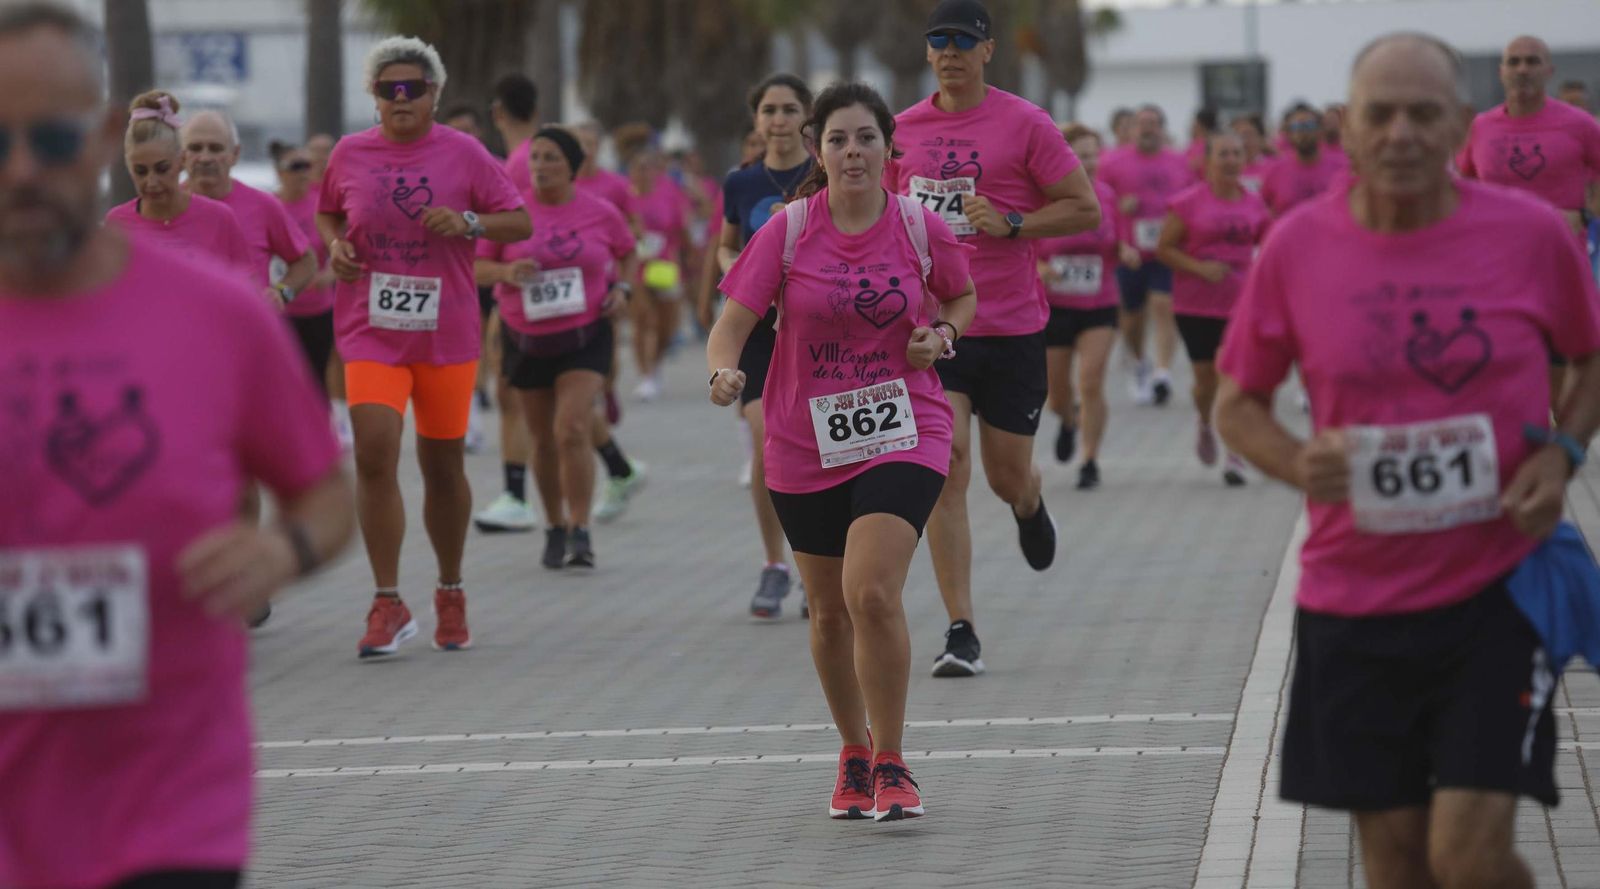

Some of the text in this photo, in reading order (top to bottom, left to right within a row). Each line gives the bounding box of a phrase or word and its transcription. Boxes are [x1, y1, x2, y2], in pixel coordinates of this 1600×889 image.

[917, 192, 962, 215] 774
[378, 289, 431, 313] 827
[531, 282, 571, 304] 897
[812, 364, 894, 386] de la Mujer
[834, 388, 904, 411] POR LA MUJER
[856, 382, 900, 400] CARRERA
[828, 402, 901, 442] 862
[1372, 450, 1473, 498] 661
